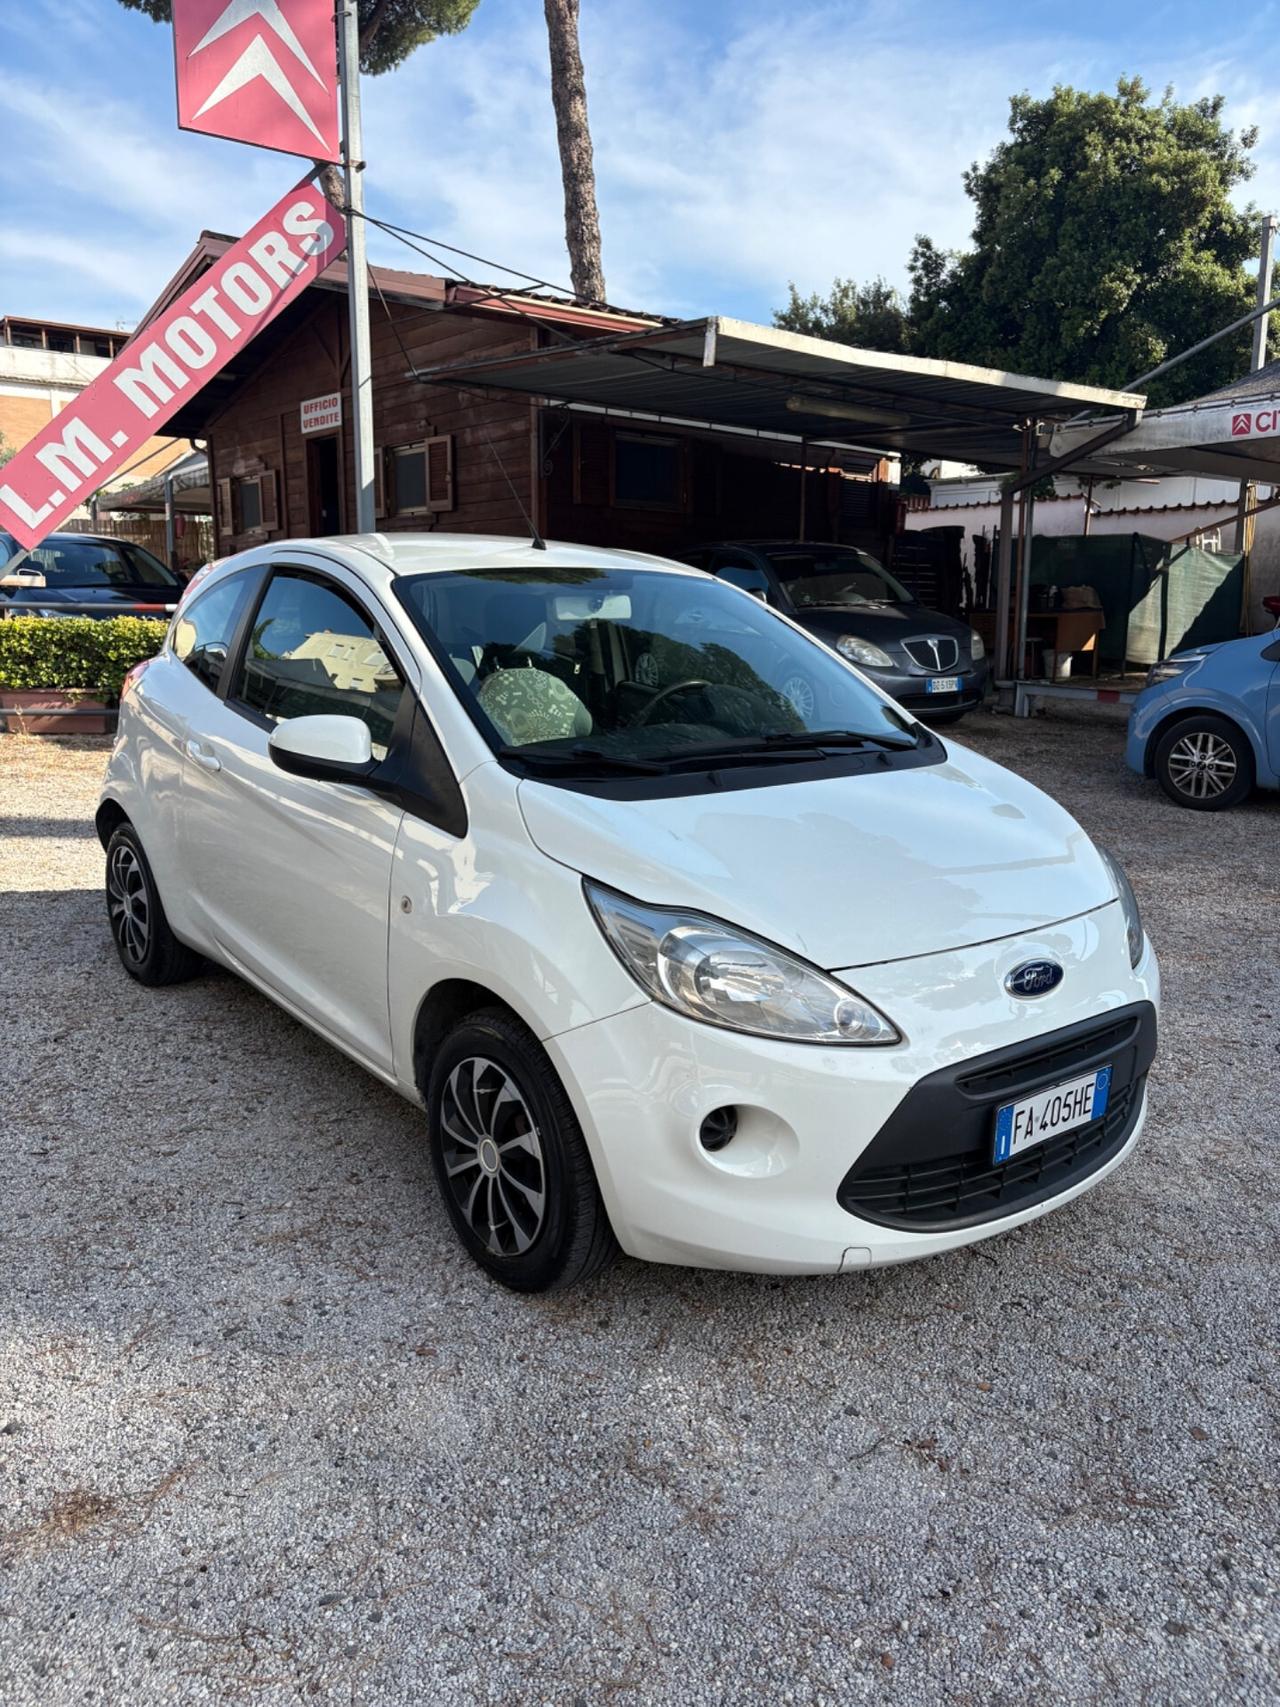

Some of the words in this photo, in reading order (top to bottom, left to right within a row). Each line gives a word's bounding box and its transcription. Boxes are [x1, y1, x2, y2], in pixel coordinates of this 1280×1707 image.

[113, 201, 335, 419] MOTORS
[303, 397, 338, 414] UFFICIO
[303, 412, 340, 429] VENDITE
[1255, 409, 1280, 432] CI
[1014, 966, 1055, 991] Ford
[1038, 1082, 1095, 1131] 405HE
